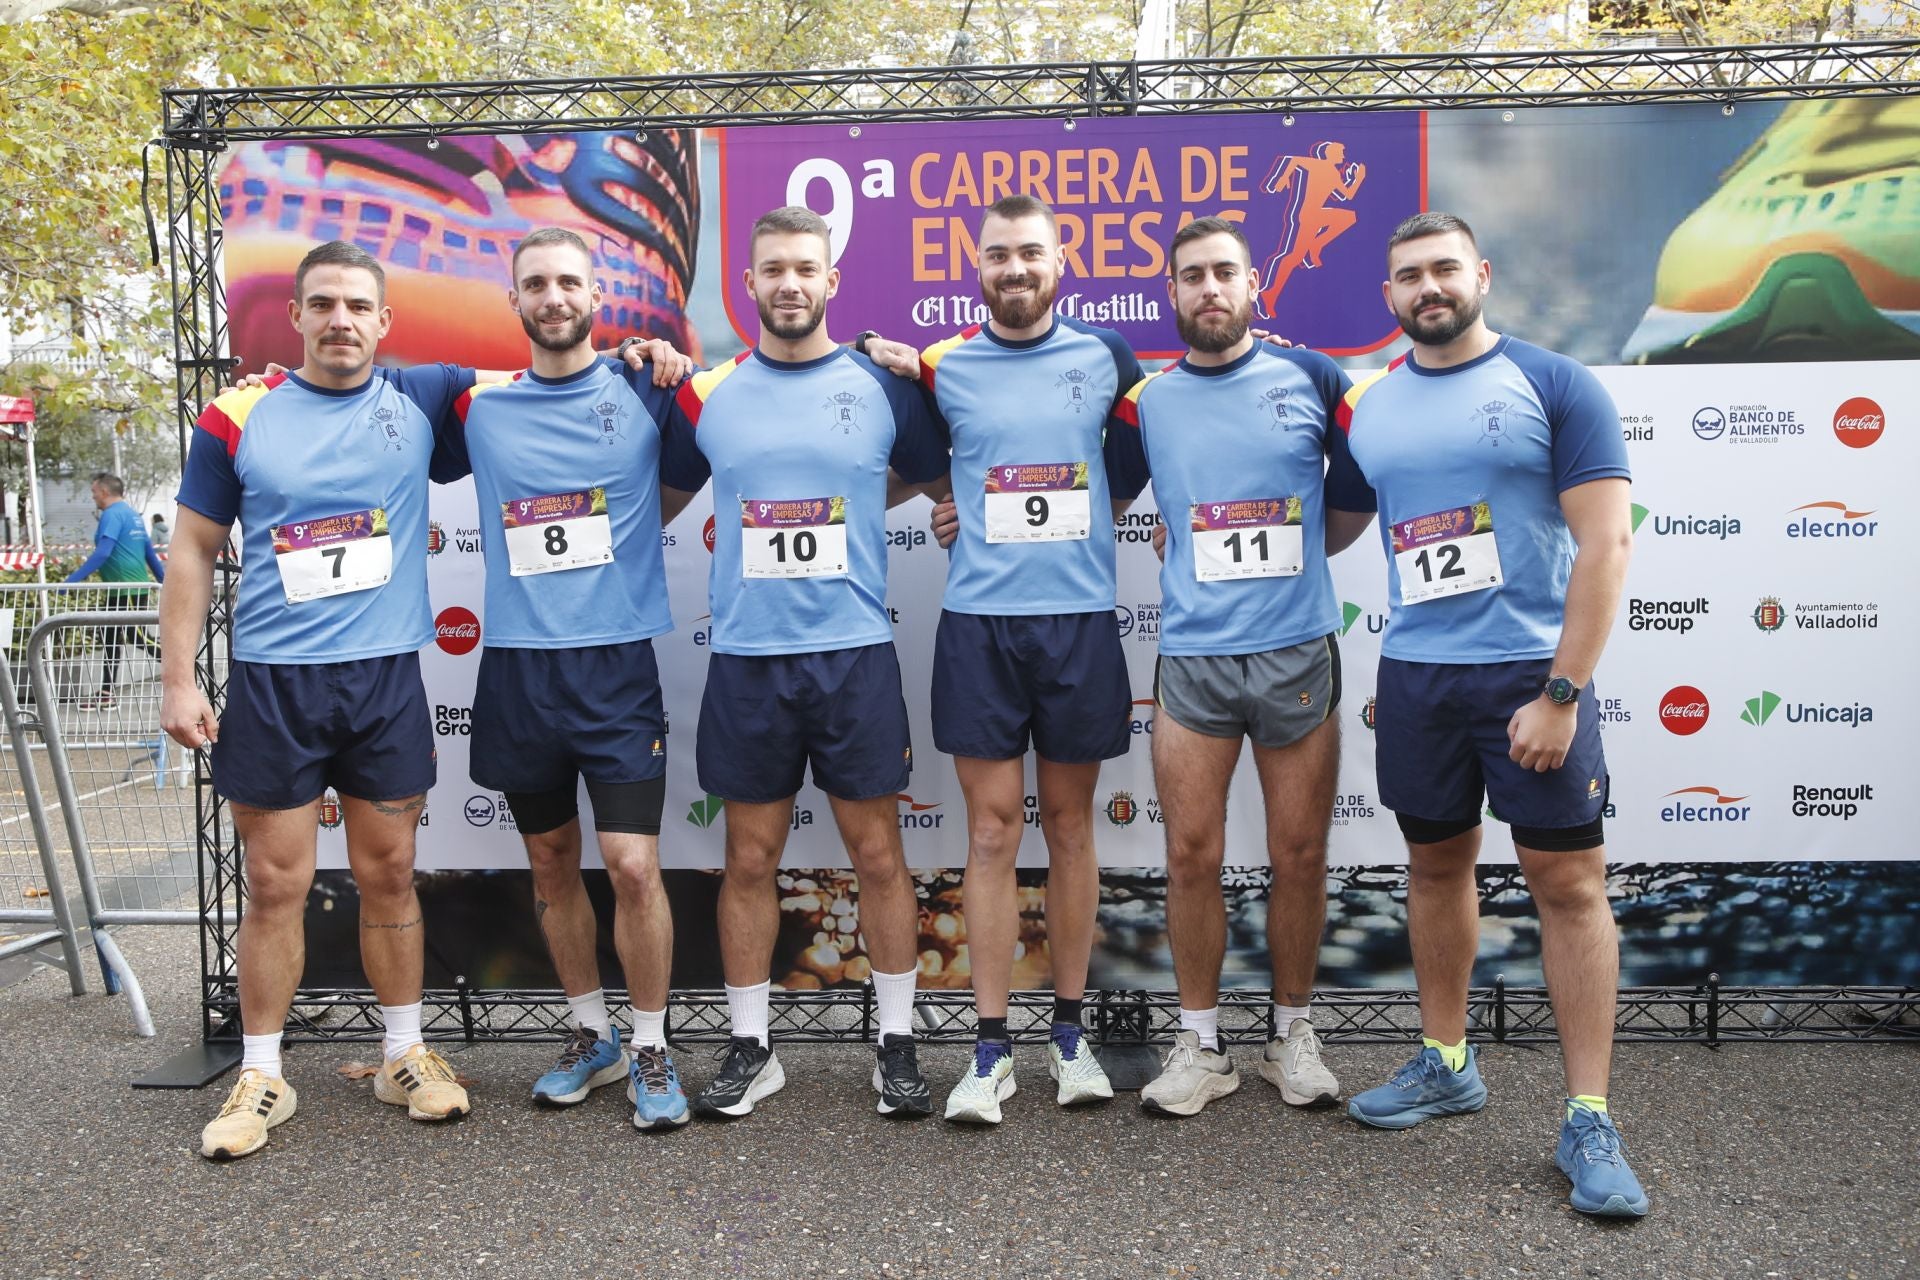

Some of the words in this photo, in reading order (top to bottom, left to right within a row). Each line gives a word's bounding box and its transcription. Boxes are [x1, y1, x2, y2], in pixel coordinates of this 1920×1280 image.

[909, 147, 1163, 209] CARRERA
[1181, 146, 1249, 203] DE
[912, 295, 946, 327] El
[1056, 292, 1161, 323] Castilla
[1642, 414, 1654, 423] de
[1730, 412, 1774, 423] BANCO
[1778, 411, 1795, 422] DE
[1836, 414, 1882, 430] Coca-Cola
[1730, 424, 1805, 436] ALIMENTOS
[1018, 466, 1048, 475] CARRERA
[1018, 474, 1058, 483] EMPRESAS
[532, 496, 561, 506] CARRERA
[533, 502, 572, 515] EMPRESAS
[772, 502, 802, 511] CARRERA
[1226, 502, 1258, 511] CARRERA
[772, 509, 812, 519] EMPRESAS
[1025, 496, 1049, 526] 9
[1227, 508, 1268, 520] EMPRESAS
[308, 518, 340, 530] CARRERA
[340, 516, 352, 524] DE
[1412, 514, 1441, 529] CARRERA
[1442, 512, 1451, 522] DE
[1414, 520, 1452, 537] EMPRESAS
[1654, 514, 1741, 540] Unicaja
[1786, 518, 1878, 538] elecnor
[310, 523, 352, 538] EMPRESAS
[544, 525, 568, 556] 8
[768, 530, 817, 562] 10
[1224, 530, 1268, 563] 11
[321, 546, 346, 579] 7
[1414, 544, 1466, 583] 12
[1629, 598, 1709, 614] Renault
[1795, 602, 1864, 613] Ayuntamiento
[1866, 602, 1878, 612] de
[1628, 614, 1694, 634] Group
[1795, 614, 1878, 630] Valladolid
[436, 624, 478, 638] Coca-Cola
[1605, 699, 1622, 710] DE
[1662, 702, 1708, 718] Coca-Cola
[1786, 702, 1872, 728] Unicaja
[436, 720, 471, 736] Gro
[1348, 795, 1364, 806] DE
[1793, 784, 1873, 801] Renault
[1334, 808, 1374, 818] ENTOS
[1660, 802, 1750, 822] elecnor
[1792, 800, 1858, 820] Group
